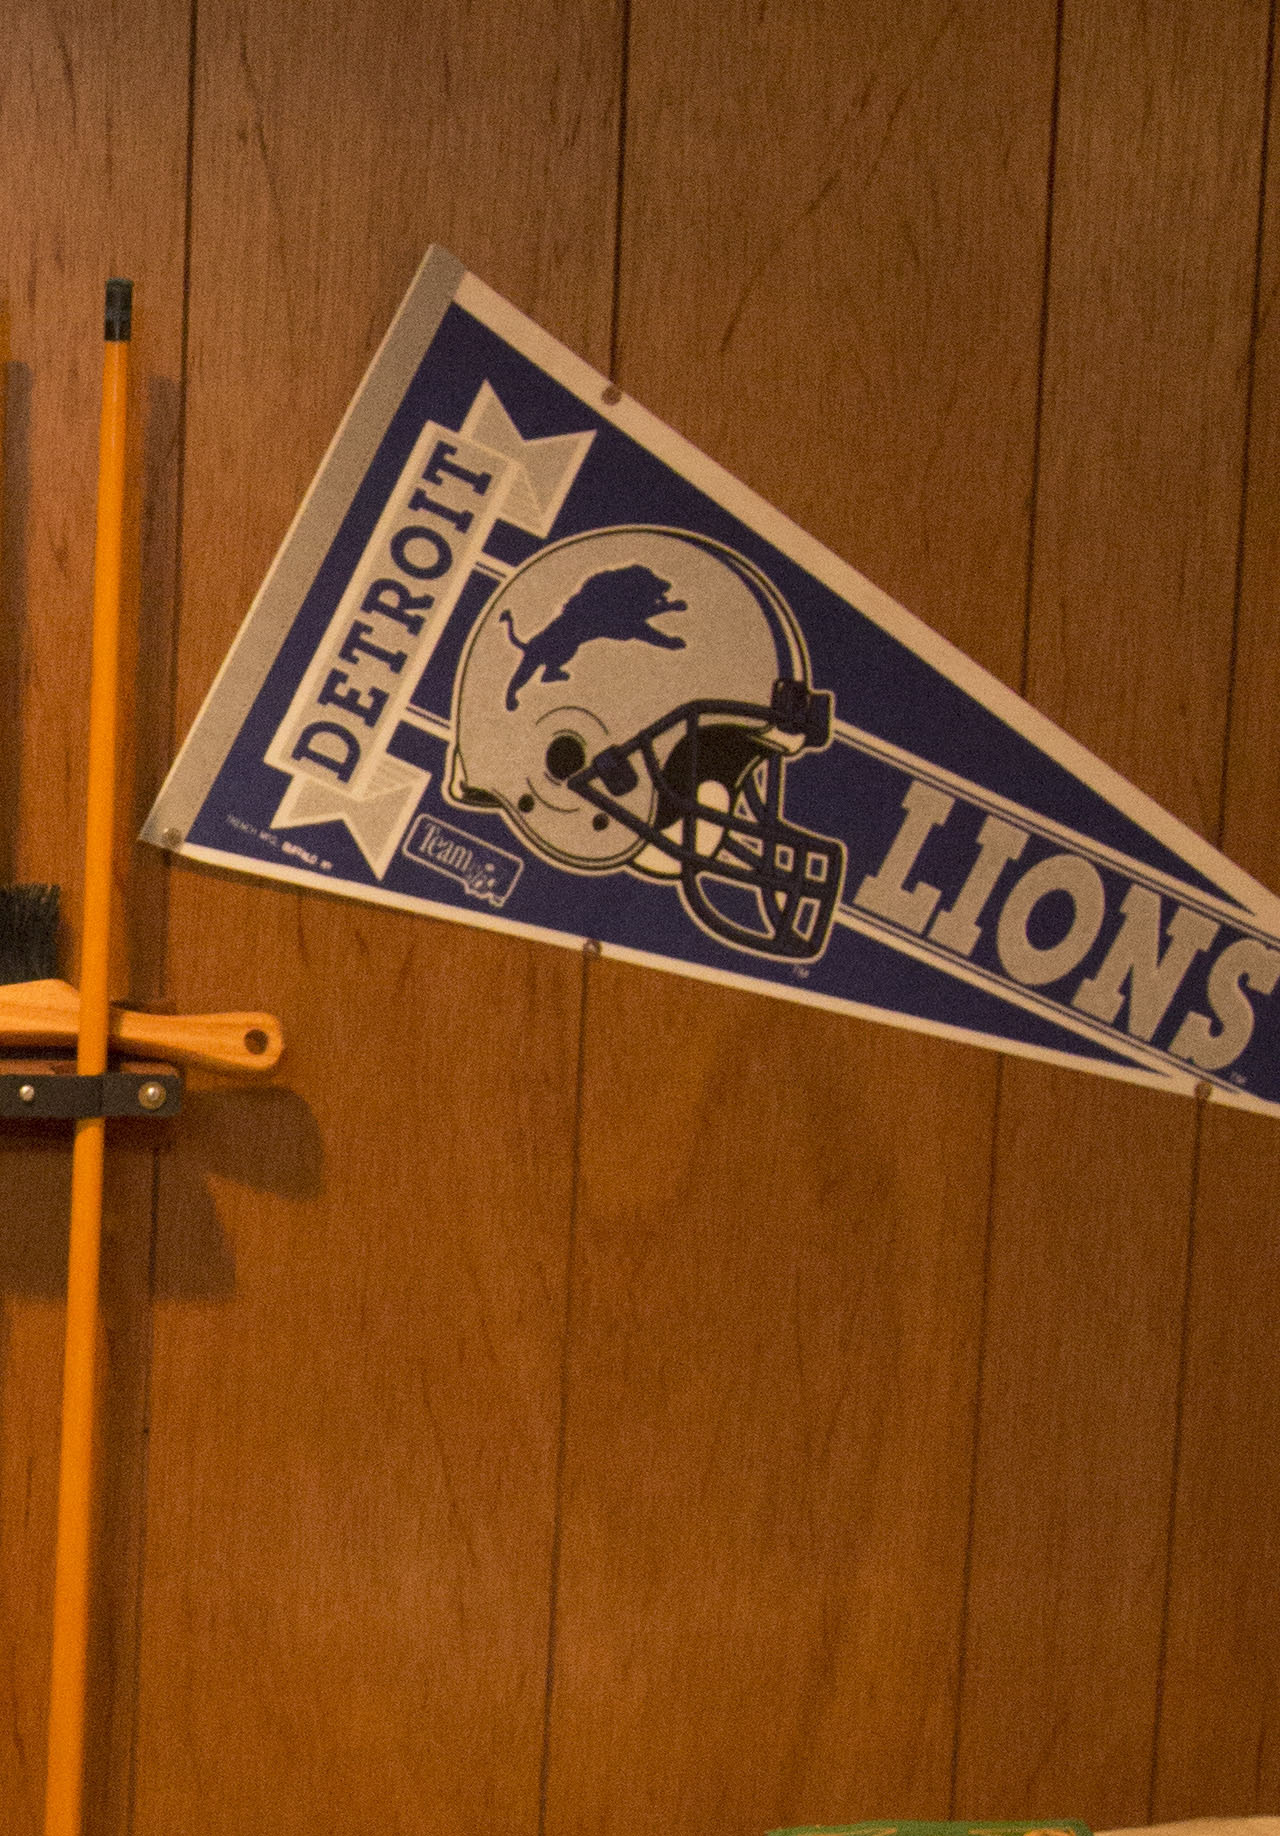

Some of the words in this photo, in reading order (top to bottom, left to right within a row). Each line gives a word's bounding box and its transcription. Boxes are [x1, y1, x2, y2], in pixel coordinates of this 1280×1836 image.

[292, 443, 495, 782] DETROIT
[418, 822, 473, 870] Team
[853, 780, 1280, 1072] LIONS
